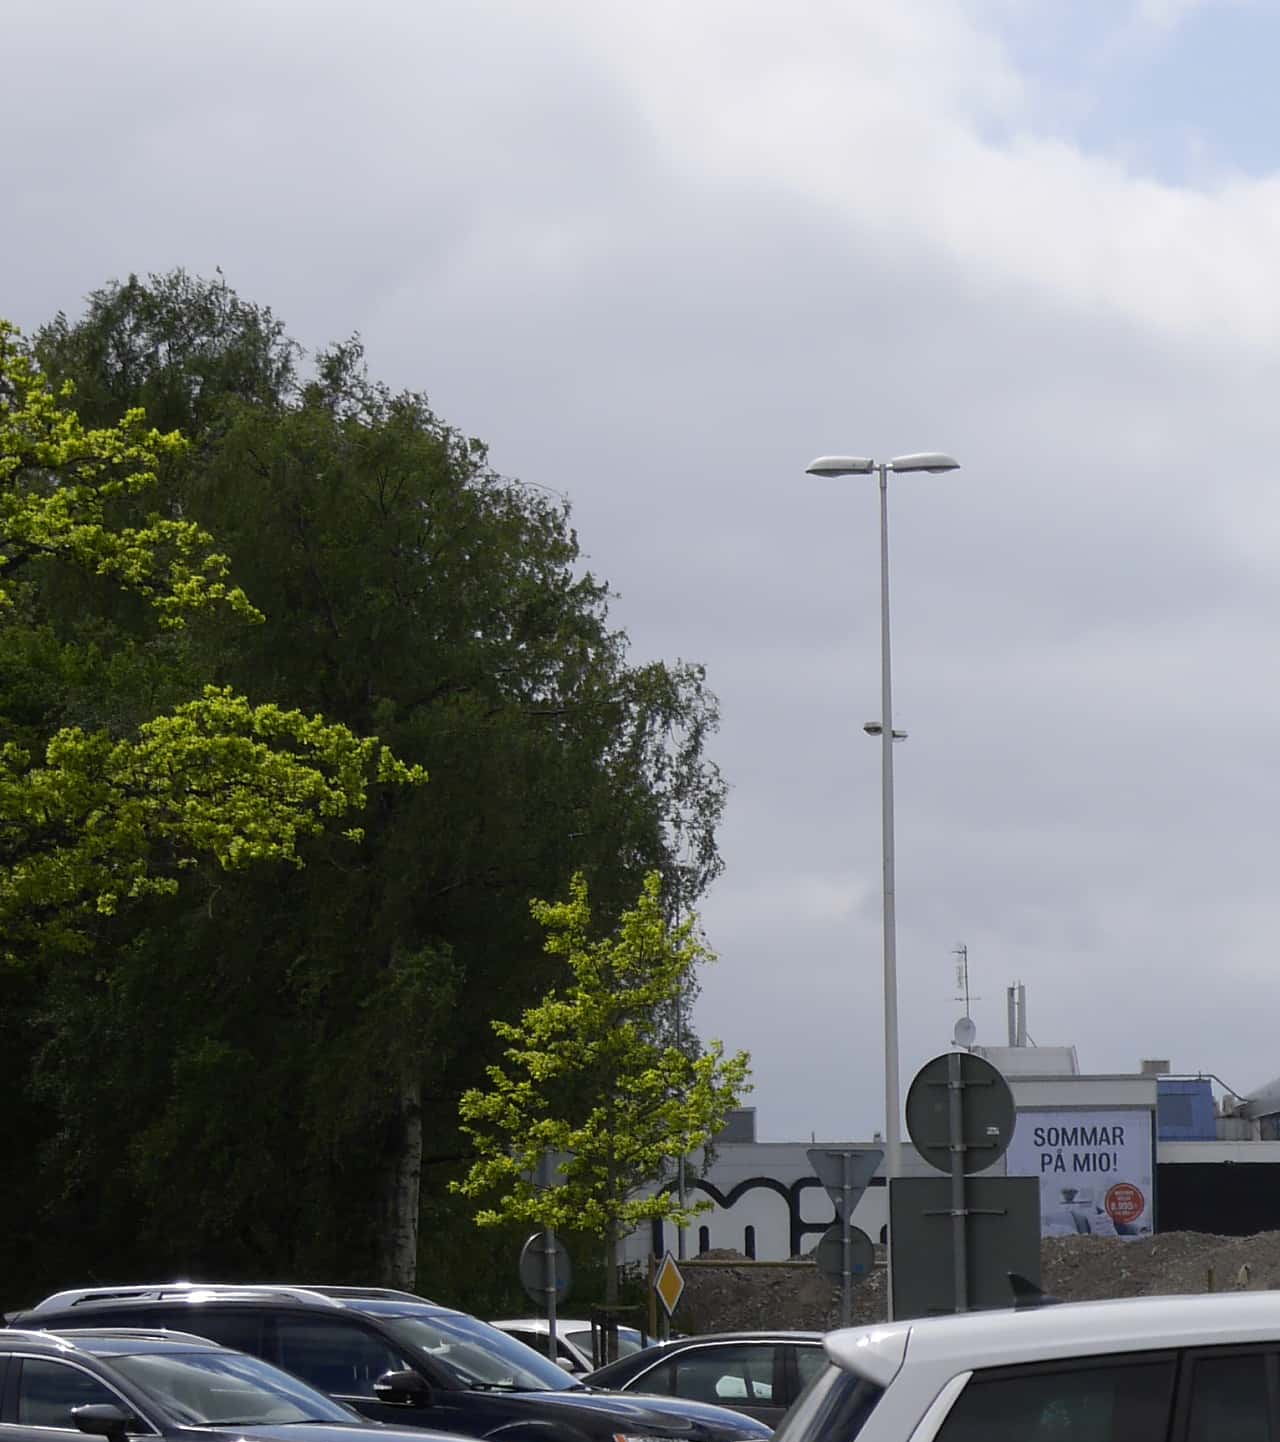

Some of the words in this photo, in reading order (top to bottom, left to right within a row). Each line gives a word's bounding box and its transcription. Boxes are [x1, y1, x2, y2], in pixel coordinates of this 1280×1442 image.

[1033, 1126, 1125, 1147] SOMMAR
[1041, 1148, 1066, 1173] PÅ
[1073, 1152, 1118, 1173] MIO!
